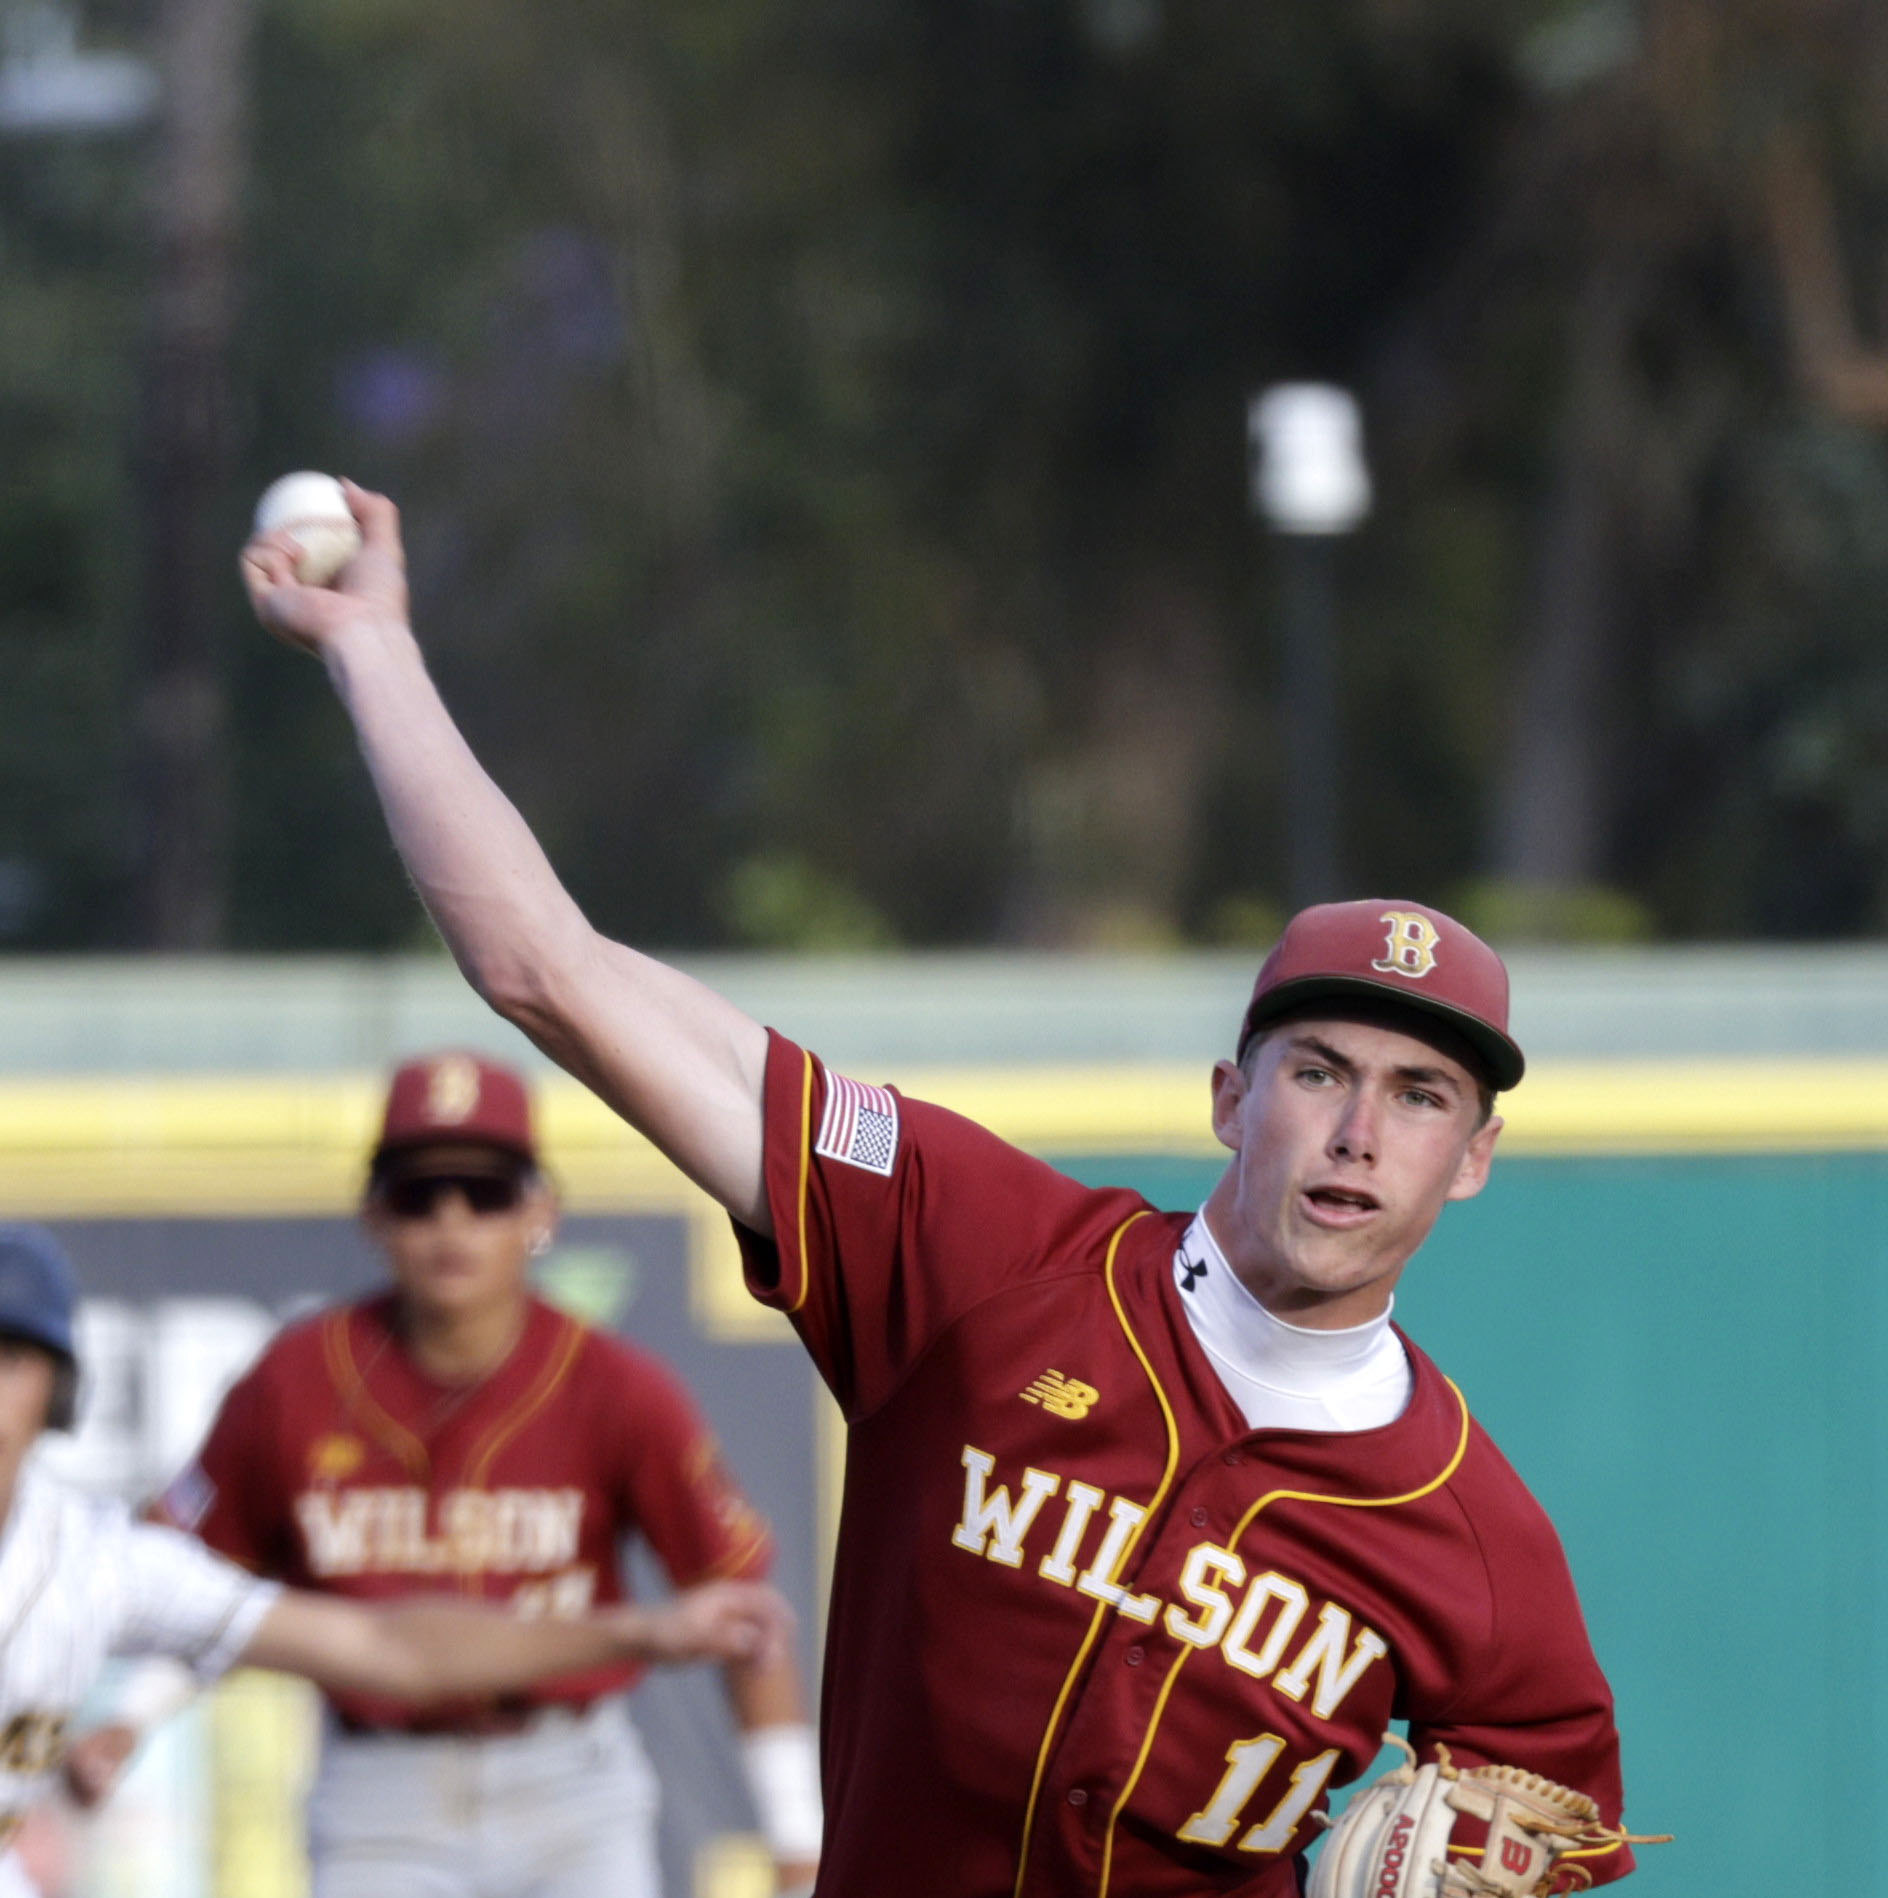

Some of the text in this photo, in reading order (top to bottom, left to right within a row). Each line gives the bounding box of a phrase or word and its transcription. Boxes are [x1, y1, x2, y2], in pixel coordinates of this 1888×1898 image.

[1371, 911, 1440, 978] B
[294, 1486, 585, 1577] WILSON
[951, 1444, 1389, 1720] WILSON
[1176, 1732, 1341, 1853] 11
